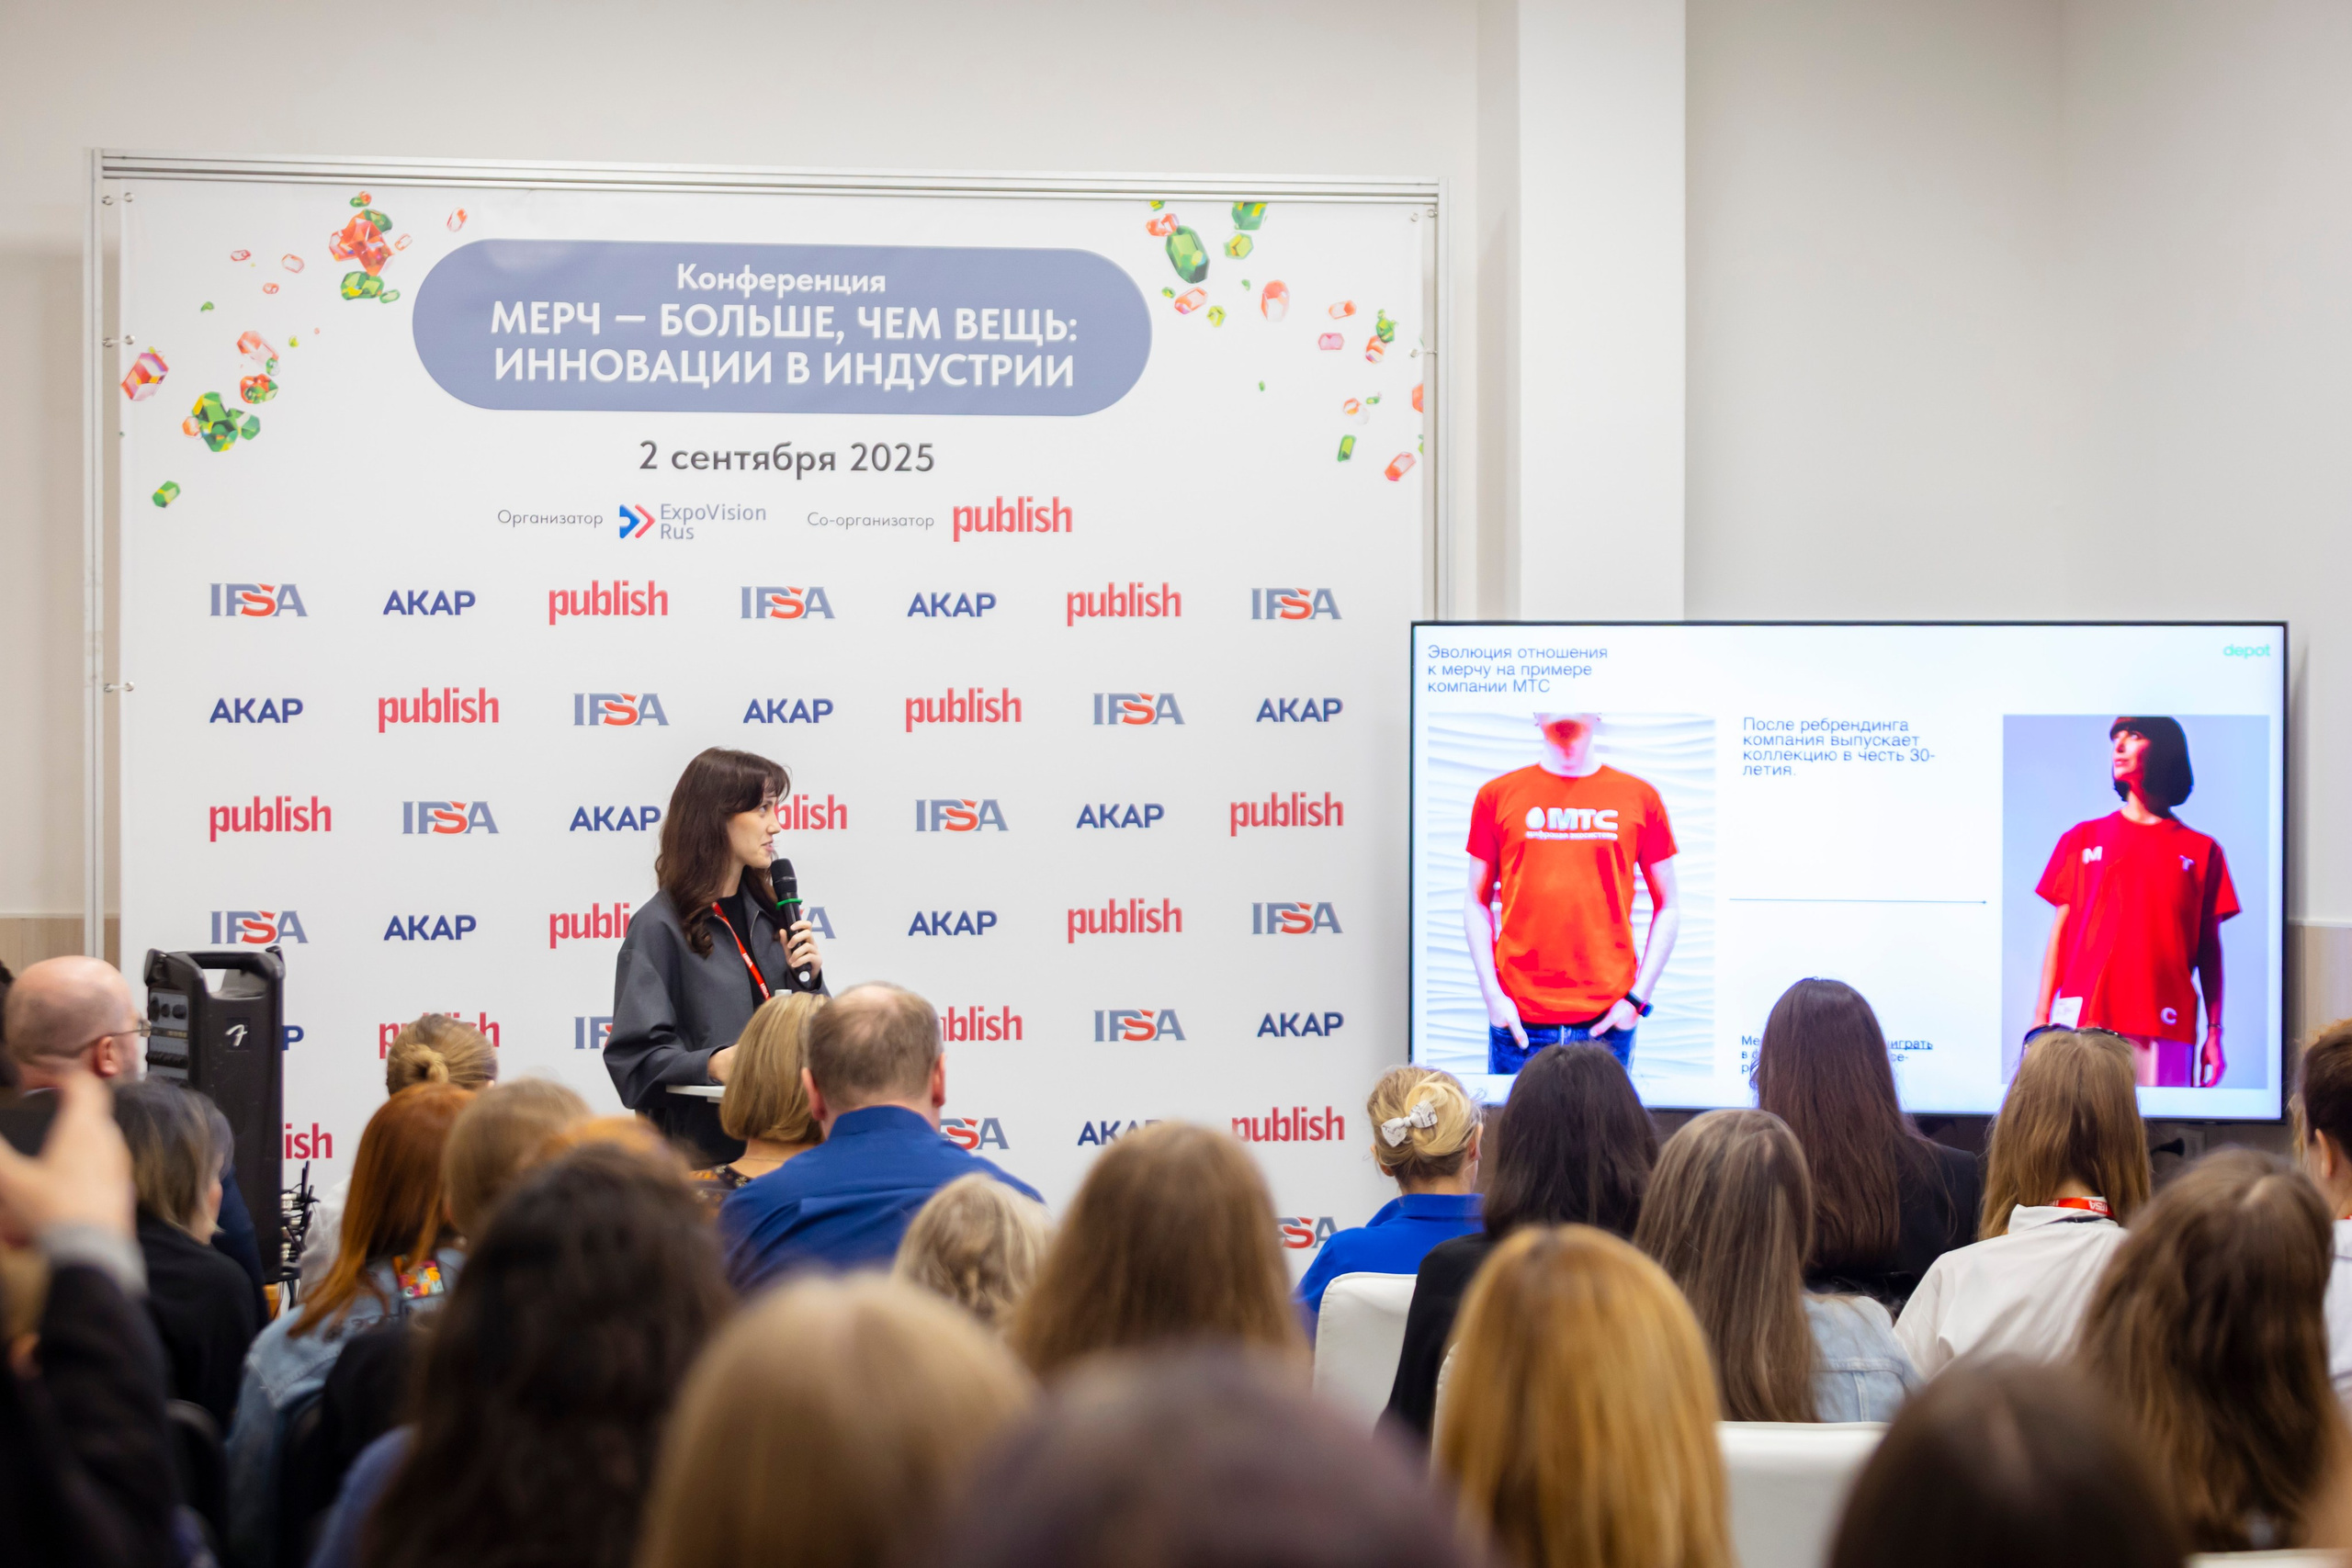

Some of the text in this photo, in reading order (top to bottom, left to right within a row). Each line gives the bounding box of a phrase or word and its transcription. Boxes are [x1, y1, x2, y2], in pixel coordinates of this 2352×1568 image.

[678, 263, 886, 299] Конференция
[491, 300, 600, 335] МЕРЧ
[661, 303, 844, 344] БОЛЬШЕ,
[858, 306, 942, 339] ЧЕМ
[956, 308, 1077, 346] ВЕЩЬ:
[495, 347, 1073, 391] ИННОВАЦИИ В ИНДУСТРИИ
[639, 440, 935, 481] 2 сентября 2025
[497, 509, 604, 529] Организатор
[661, 503, 766, 523] ExpoVision
[807, 512, 934, 531] Со-организатор
[953, 495, 1073, 543] publish
[661, 524, 695, 540] Rus
[210, 583, 308, 616] IPSA
[383, 590, 477, 616] АКАР
[548, 581, 669, 626] publish
[741, 587, 835, 619] IPSA
[908, 592, 997, 617] АКАР
[1067, 582, 1182, 627] publish
[1252, 588, 1342, 620] IPSA
[1428, 645, 1608, 660] Эволюция отношения
[2222, 643, 2271, 660] depot
[1428, 665, 1592, 679] к мерчу на примере
[1428, 679, 1551, 694] компании МТС
[209, 698, 304, 724] АКАР
[378, 687, 500, 733] publish
[573, 694, 670, 727] IPSA
[742, 698, 834, 724] АКАР
[905, 687, 1023, 733] publish
[1093, 694, 1185, 726] IPSA
[1255, 698, 1344, 723] АКАР
[1743, 716, 1910, 734] После ребрендинга
[1743, 736, 1920, 750] компания выпускает
[1743, 748, 1937, 763] коллекцию в честь 30-
[1742, 764, 1797, 776] летия.
[209, 795, 332, 843] publish
[403, 801, 500, 834] IPSA
[569, 806, 662, 831] АКАР
[775, 794, 848, 831] blish
[916, 799, 1010, 832] IPSA
[1075, 804, 1165, 829] АКАР
[1230, 791, 1344, 838] publish
[1547, 807, 1619, 830] МТС
[211, 911, 309, 944] IPSA
[384, 915, 477, 942] АКАР
[549, 902, 630, 949] publi
[908, 910, 998, 936] АКАР
[1067, 897, 1183, 943] publish
[1252, 902, 1343, 935] IPSA
[940, 1006, 1023, 1042] blish
[1095, 1009, 1186, 1042] IPSA
[1256, 1012, 1345, 1038] АКАР
[940, 1117, 1010, 1150] PSA
